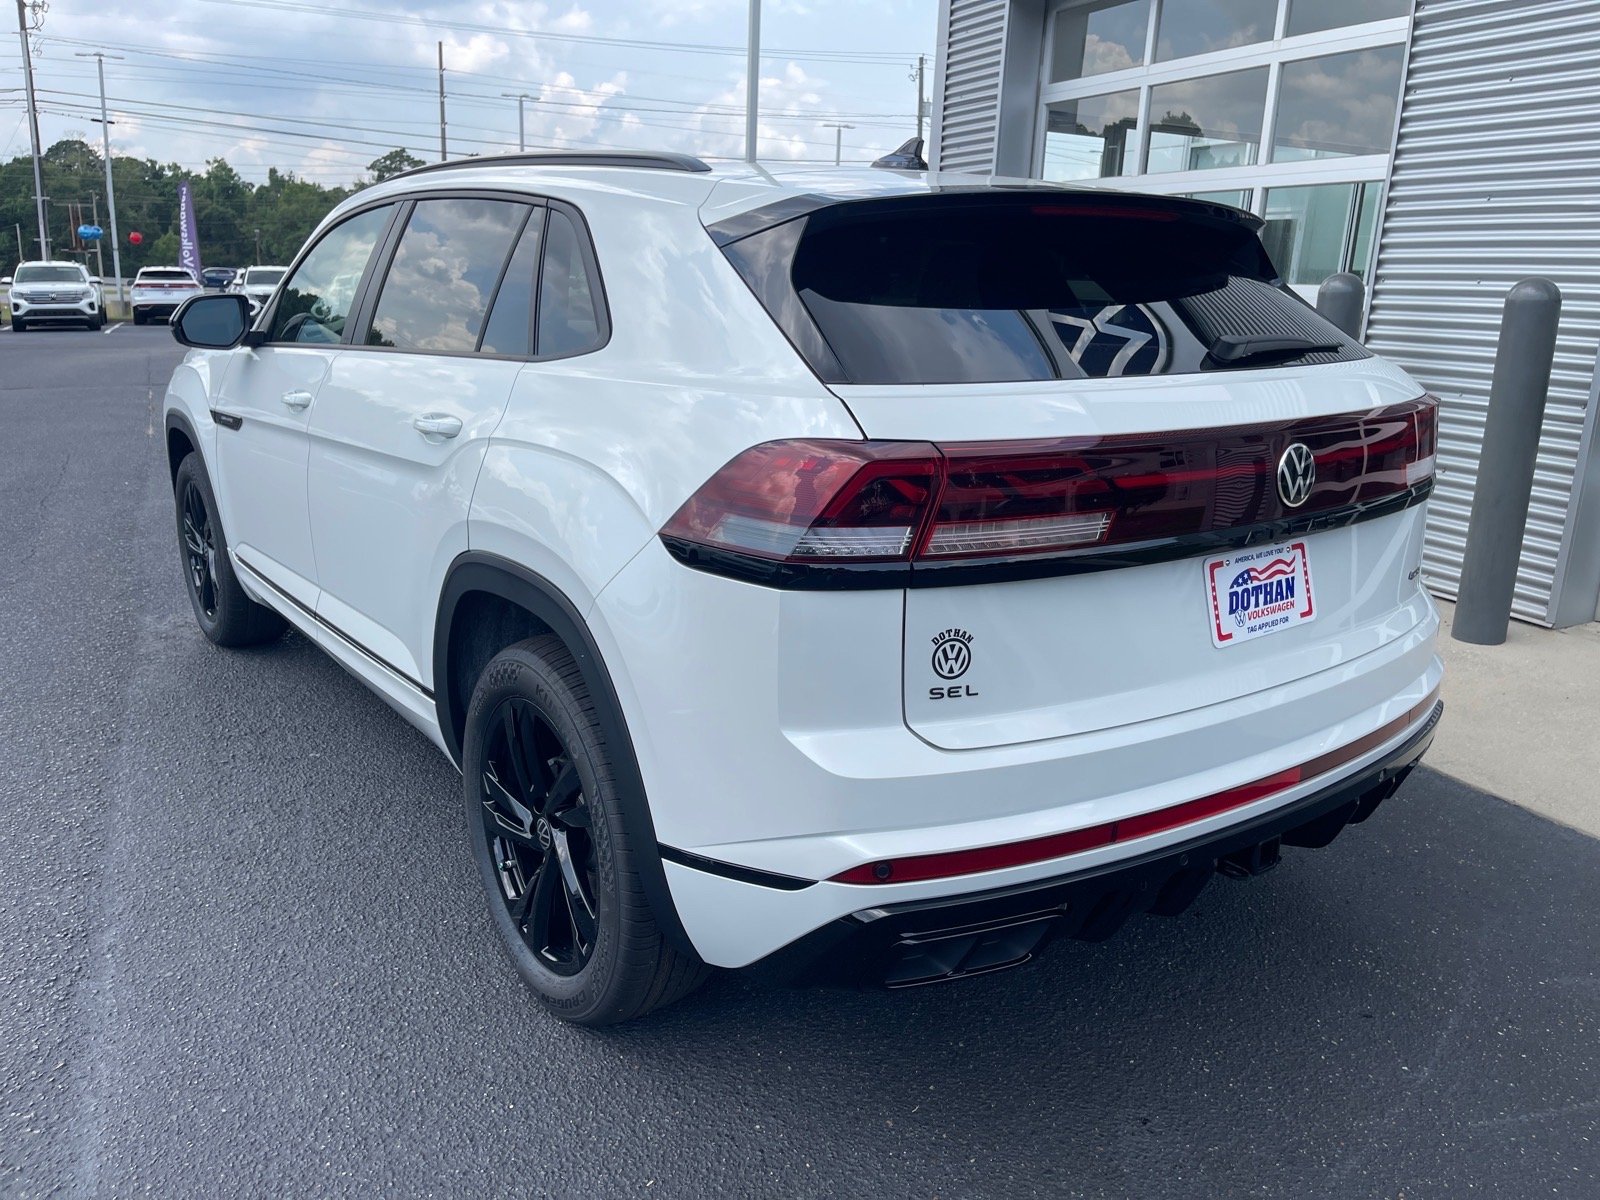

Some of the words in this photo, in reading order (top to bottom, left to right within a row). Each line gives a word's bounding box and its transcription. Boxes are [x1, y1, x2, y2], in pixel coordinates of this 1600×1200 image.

[1277, 443, 1315, 507] VW
[1234, 554, 1255, 564] AMERICA,
[1263, 549, 1274, 557] LOVE
[1228, 576, 1295, 615] DOTHAN
[1247, 600, 1295, 621] VOLKSWAGEN
[1247, 625, 1257, 634] TAG
[1258, 619, 1279, 631] APPLIED
[1279, 616, 1289, 625] FOR
[931, 628, 974, 646] DOTHAN
[932, 638, 971, 680] VW
[929, 685, 979, 700] SEL
